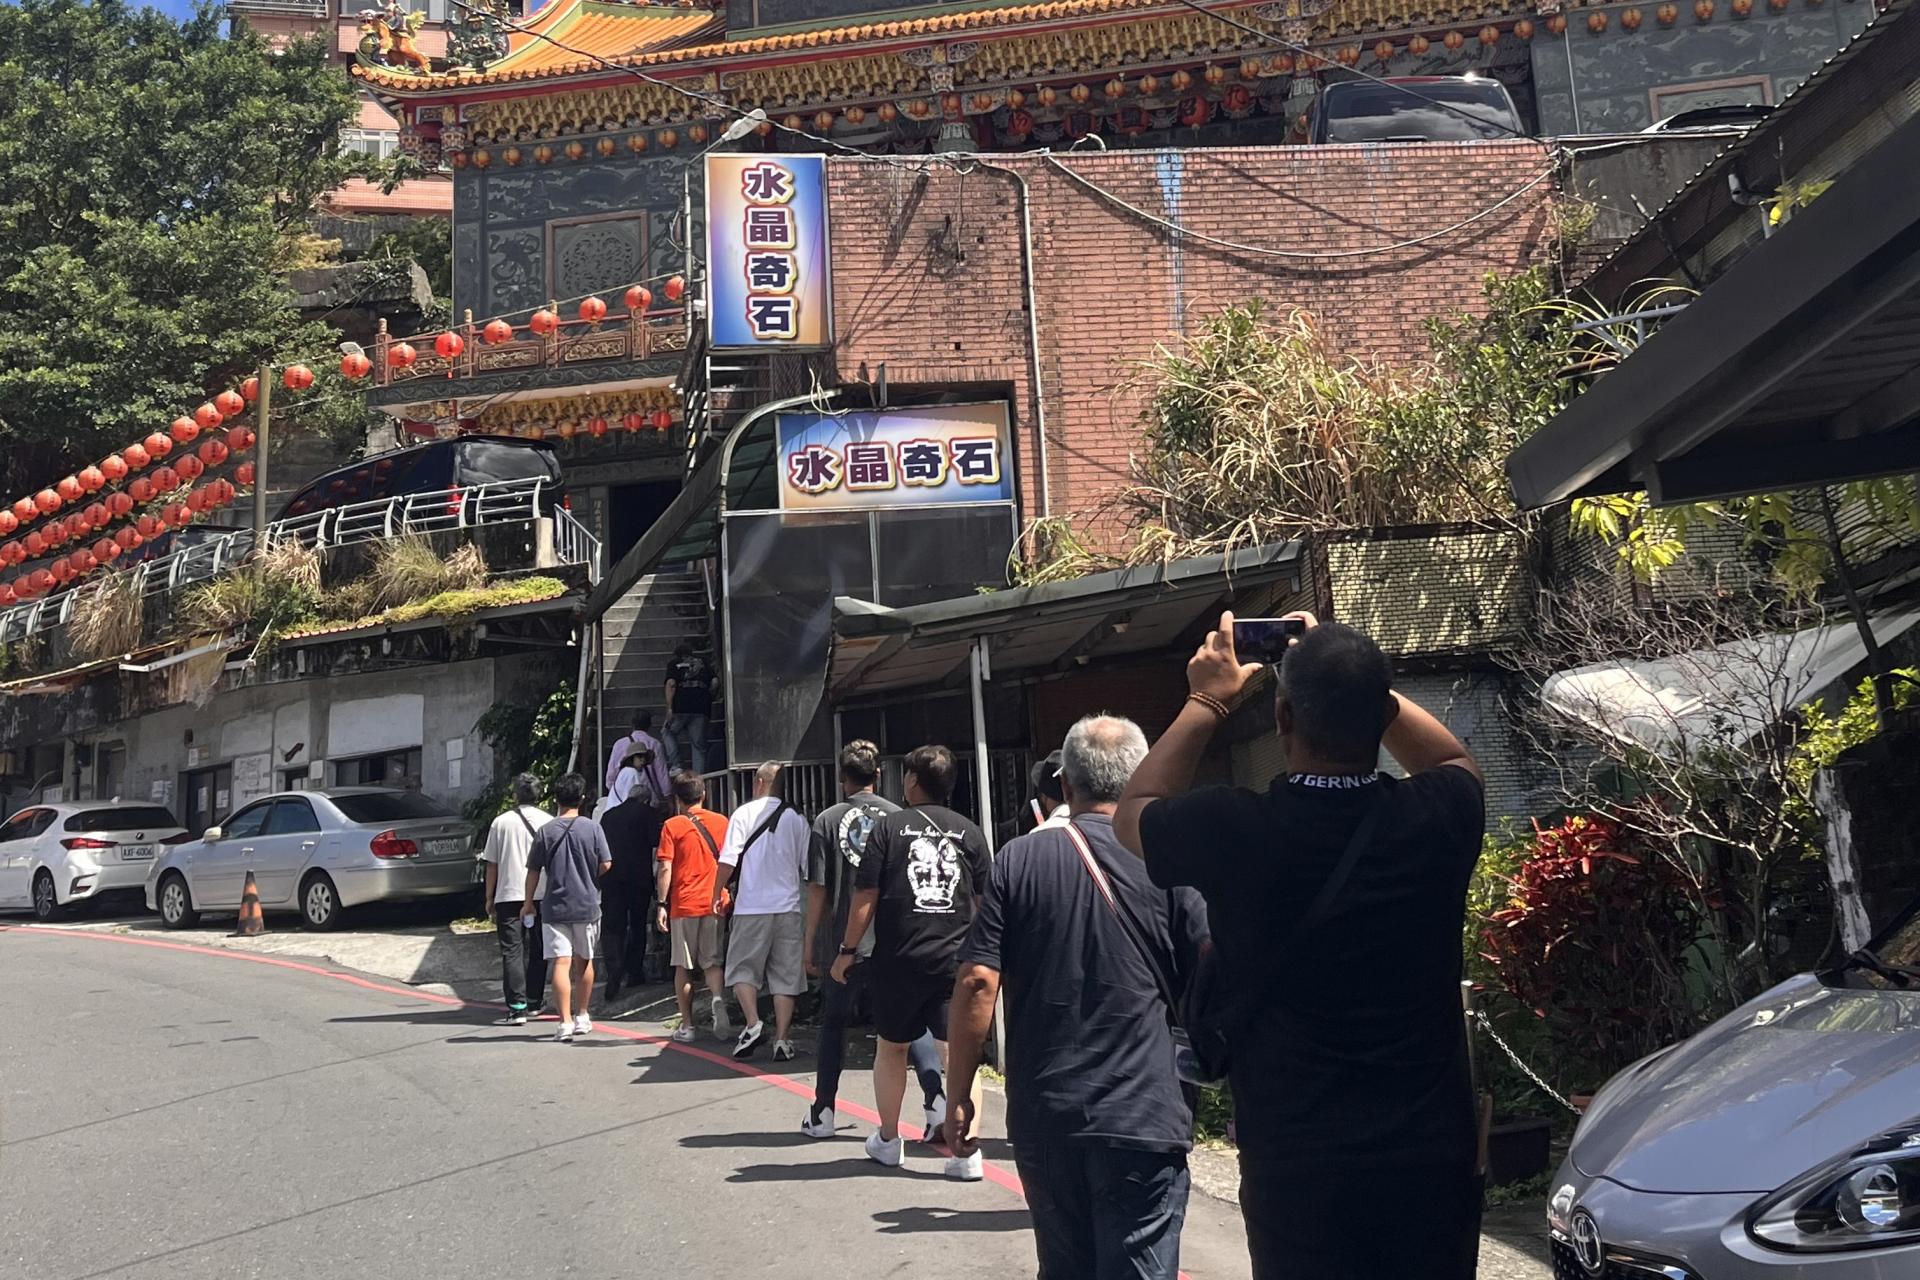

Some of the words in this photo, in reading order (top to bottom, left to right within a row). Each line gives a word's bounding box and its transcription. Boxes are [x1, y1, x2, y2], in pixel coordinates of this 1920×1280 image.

[745, 165, 794, 334] 水晶奇石
[791, 440, 997, 488] 水晶奇石
